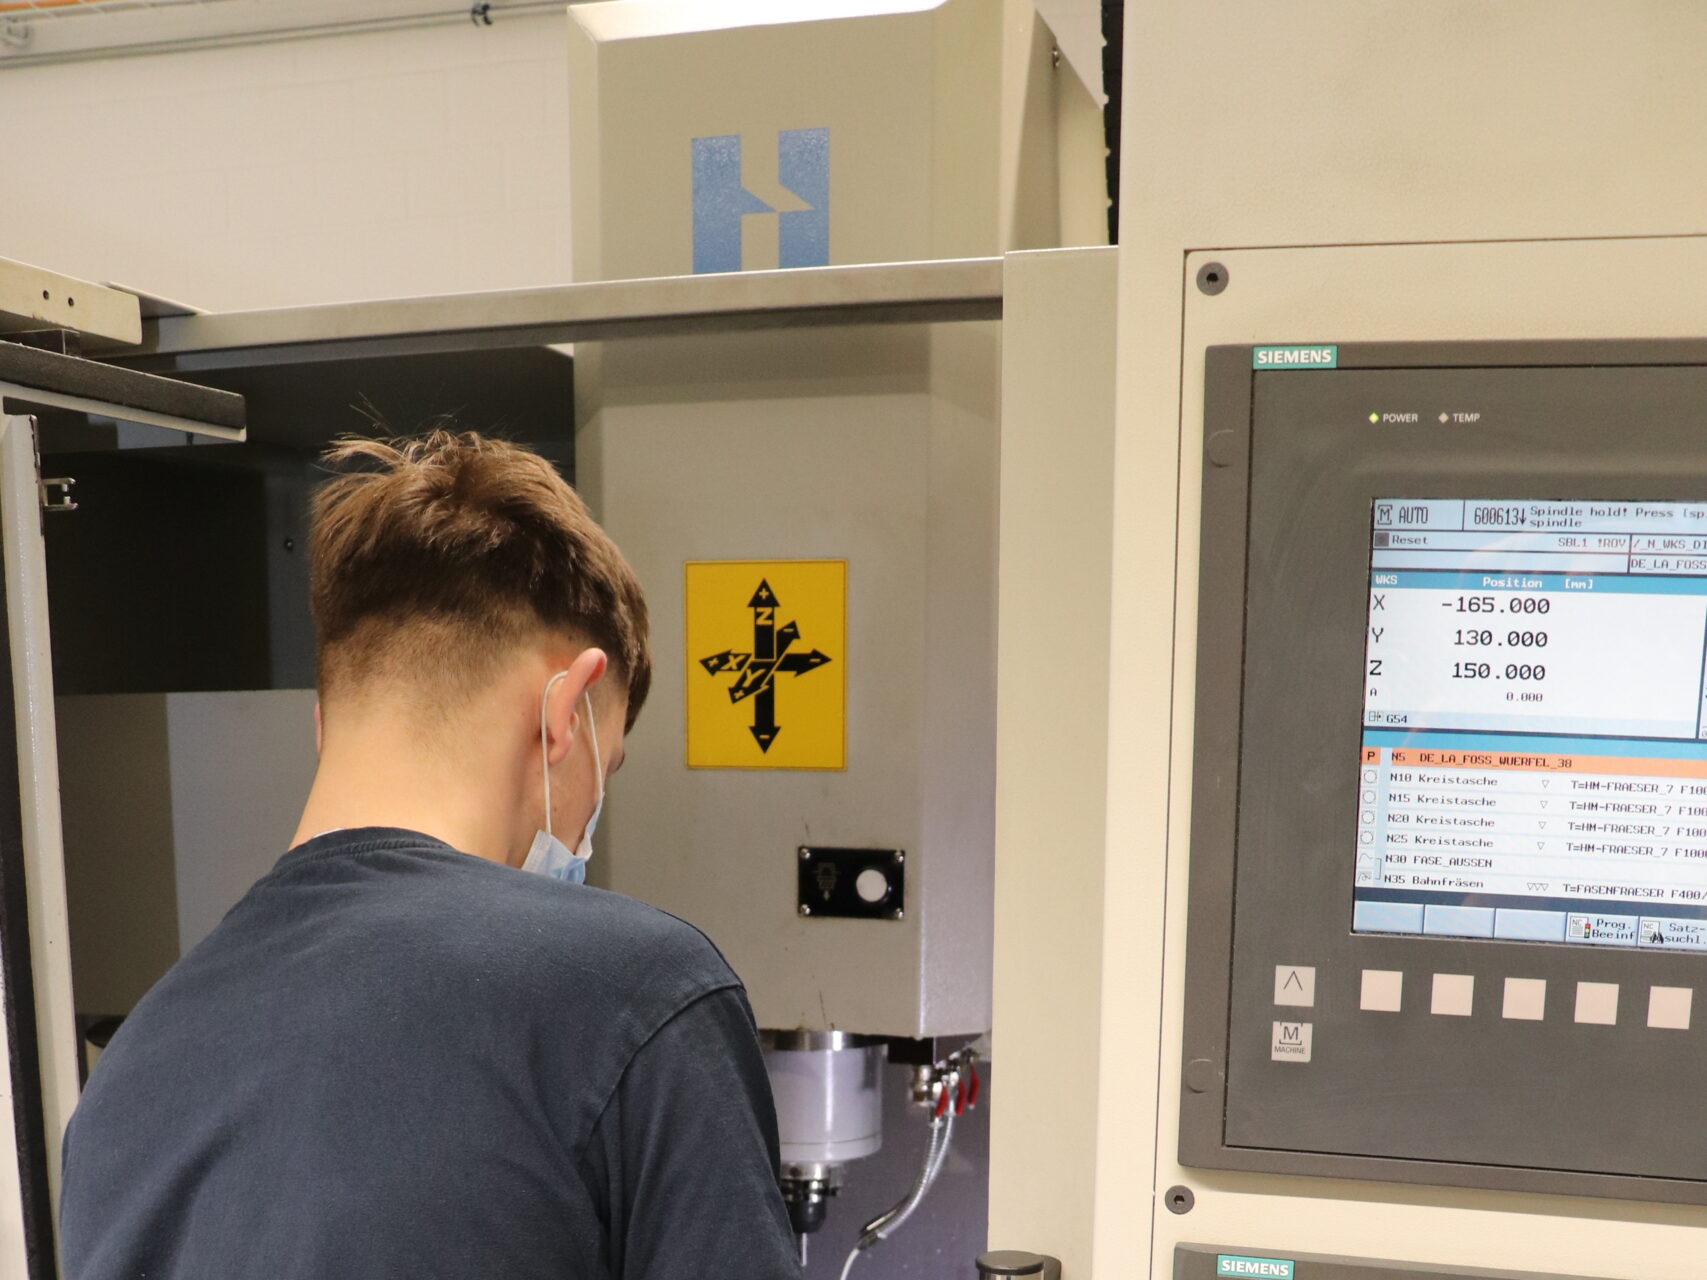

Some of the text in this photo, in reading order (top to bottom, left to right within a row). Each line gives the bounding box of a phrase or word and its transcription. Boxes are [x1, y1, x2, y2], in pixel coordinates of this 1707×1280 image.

[1258, 350, 1331, 364] SIEMENS
[1383, 413, 1418, 422] POWER
[1453, 413, 1480, 422] TEMP
[1399, 506, 1428, 524] AUTO
[1530, 506, 1707, 520] Spindle hold! Press [sp
[1530, 518, 1582, 528] spindle
[1392, 535, 1428, 544] Reset
[1558, 538, 1587, 547] SBL1
[1376, 575, 1397, 584] WKS
[1483, 577, 1542, 588] Position
[1373, 595, 1550, 614] X -165.000
[756, 607, 772, 625] Z
[1372, 627, 1547, 647] Y 130.000
[720, 655, 745, 670] X
[1369, 660, 1545, 680] Z 150.000
[742, 668, 766, 688] Y
[1370, 688, 1543, 702] A 0.000
[1386, 714, 1407, 723] G54
[1367, 752, 1375, 760] P
[1392, 752, 1572, 770] N5 DE_LA_FOSS_WUERFEL_38
[1390, 773, 1412, 782] N10
[1418, 774, 1498, 786] Kreistasche
[1389, 794, 1410, 803] N15
[1417, 795, 1496, 806] Kreistasche
[1388, 814, 1409, 823] N20
[1416, 815, 1495, 827] Kreistasche
[1386, 834, 1408, 843] N25
[1415, 835, 1494, 847] Kreistasche
[1385, 855, 1492, 868] N30 FASE_AUSSEN
[1384, 875, 1405, 884] N35
[1412, 876, 1483, 888] Bahnfräsen
[1597, 918, 1631, 930] Prog.
[1592, 929, 1635, 940] Beeinf
[1283, 1026, 1298, 1040] M
[1274, 1046, 1305, 1054] MACHINE
[1222, 1260, 1288, 1276] SIEMENS
